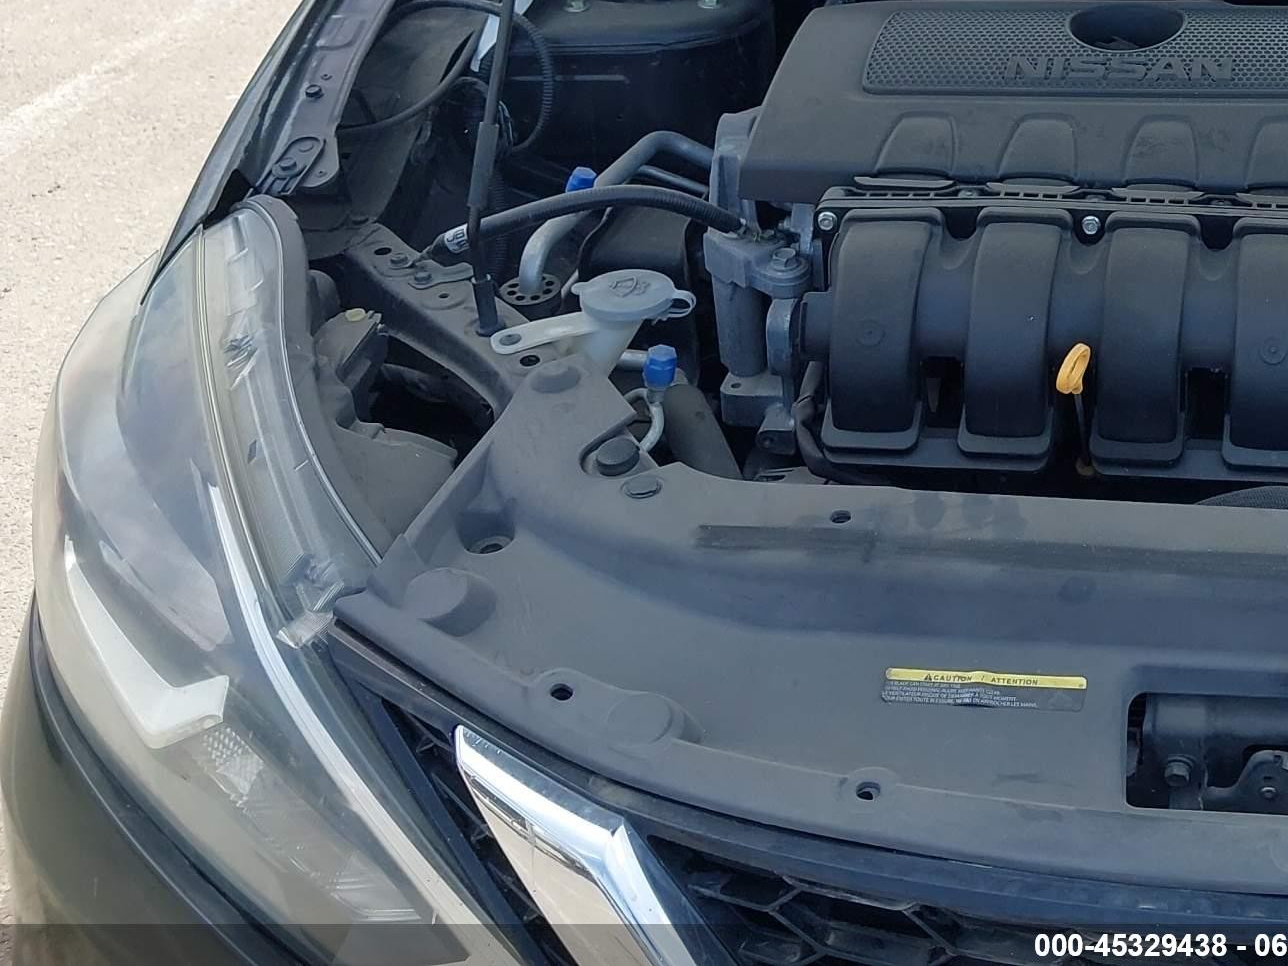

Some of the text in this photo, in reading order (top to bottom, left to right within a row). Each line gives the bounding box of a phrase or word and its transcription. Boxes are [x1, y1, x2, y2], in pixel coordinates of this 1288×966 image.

[1002, 55, 1233, 82] NISSAN
[933, 674, 973, 682] CAUTION
[990, 677, 1038, 685] ATTENTION
